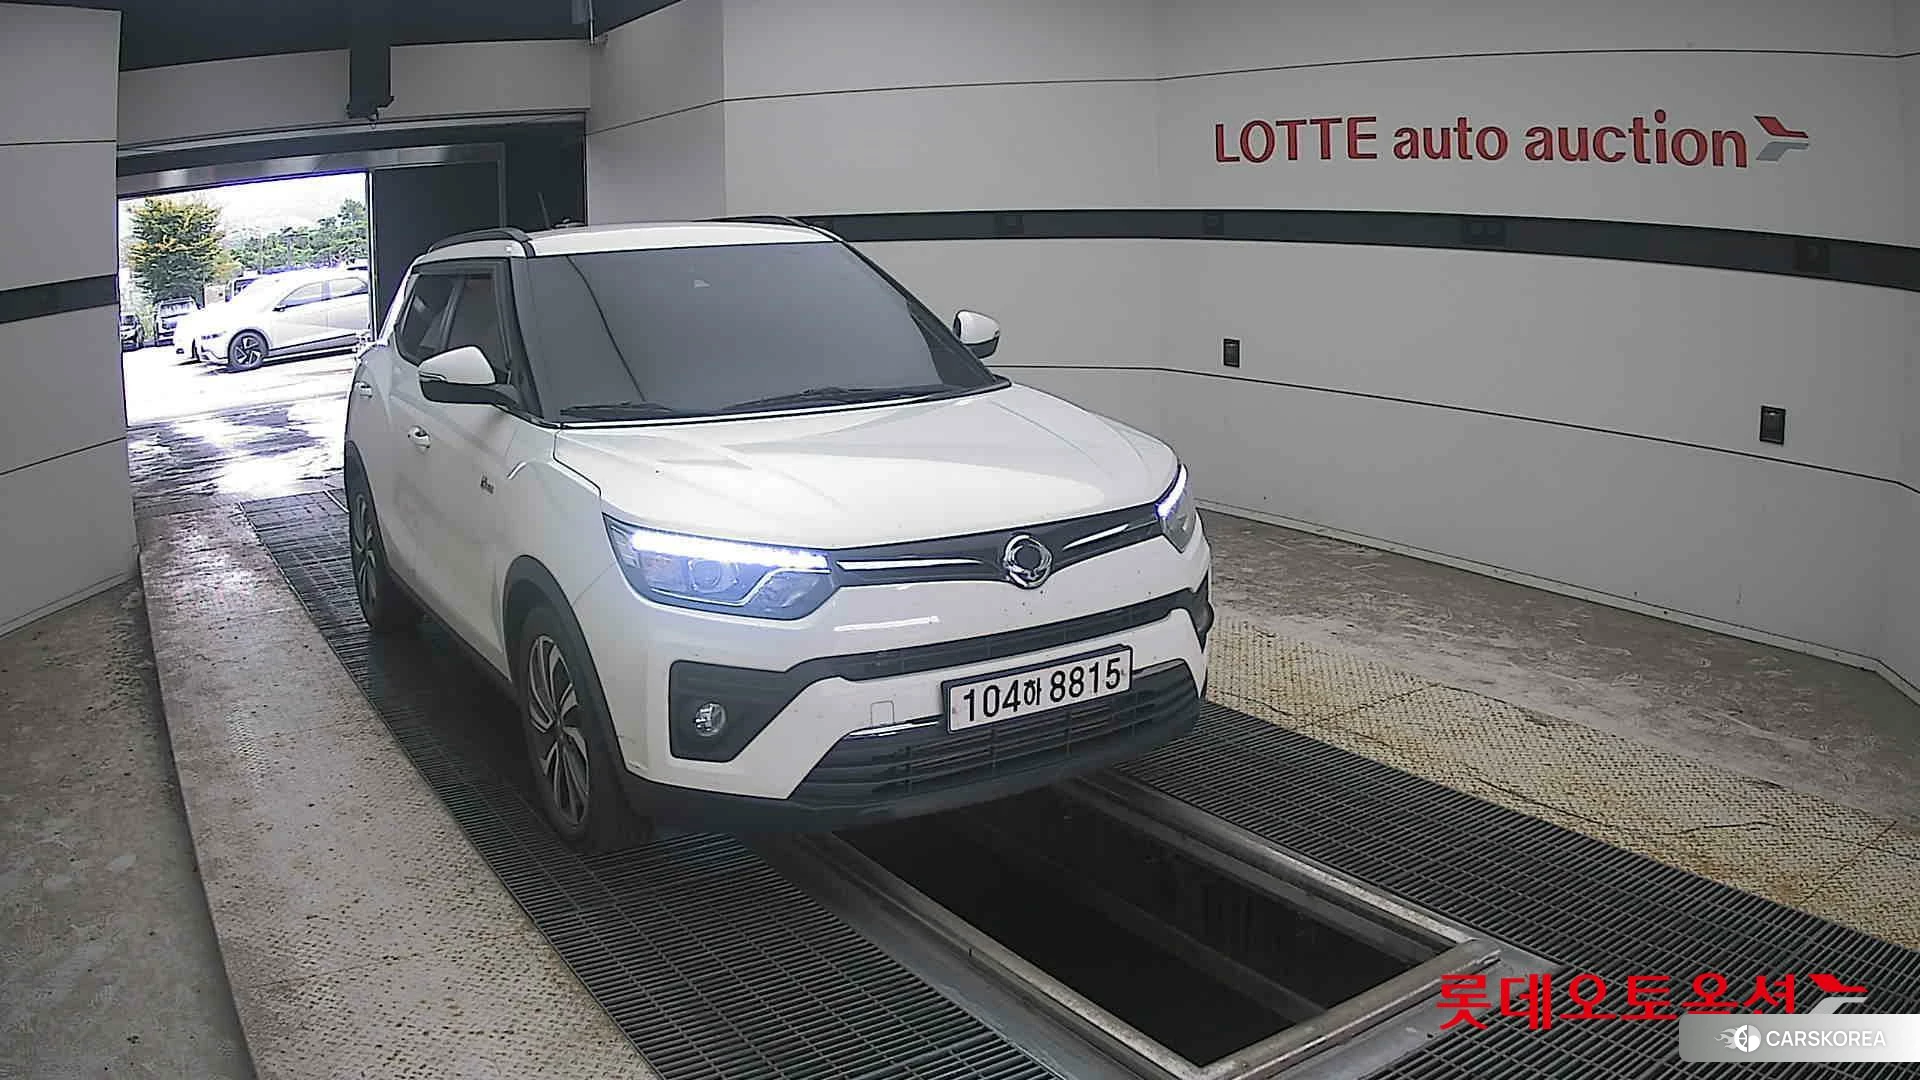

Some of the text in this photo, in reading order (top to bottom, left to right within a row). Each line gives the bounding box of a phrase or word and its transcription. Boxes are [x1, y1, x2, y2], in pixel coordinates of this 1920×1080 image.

[1214, 109, 1748, 168] LOTTE auto auction
[1050, 657, 1121, 703] 8815
